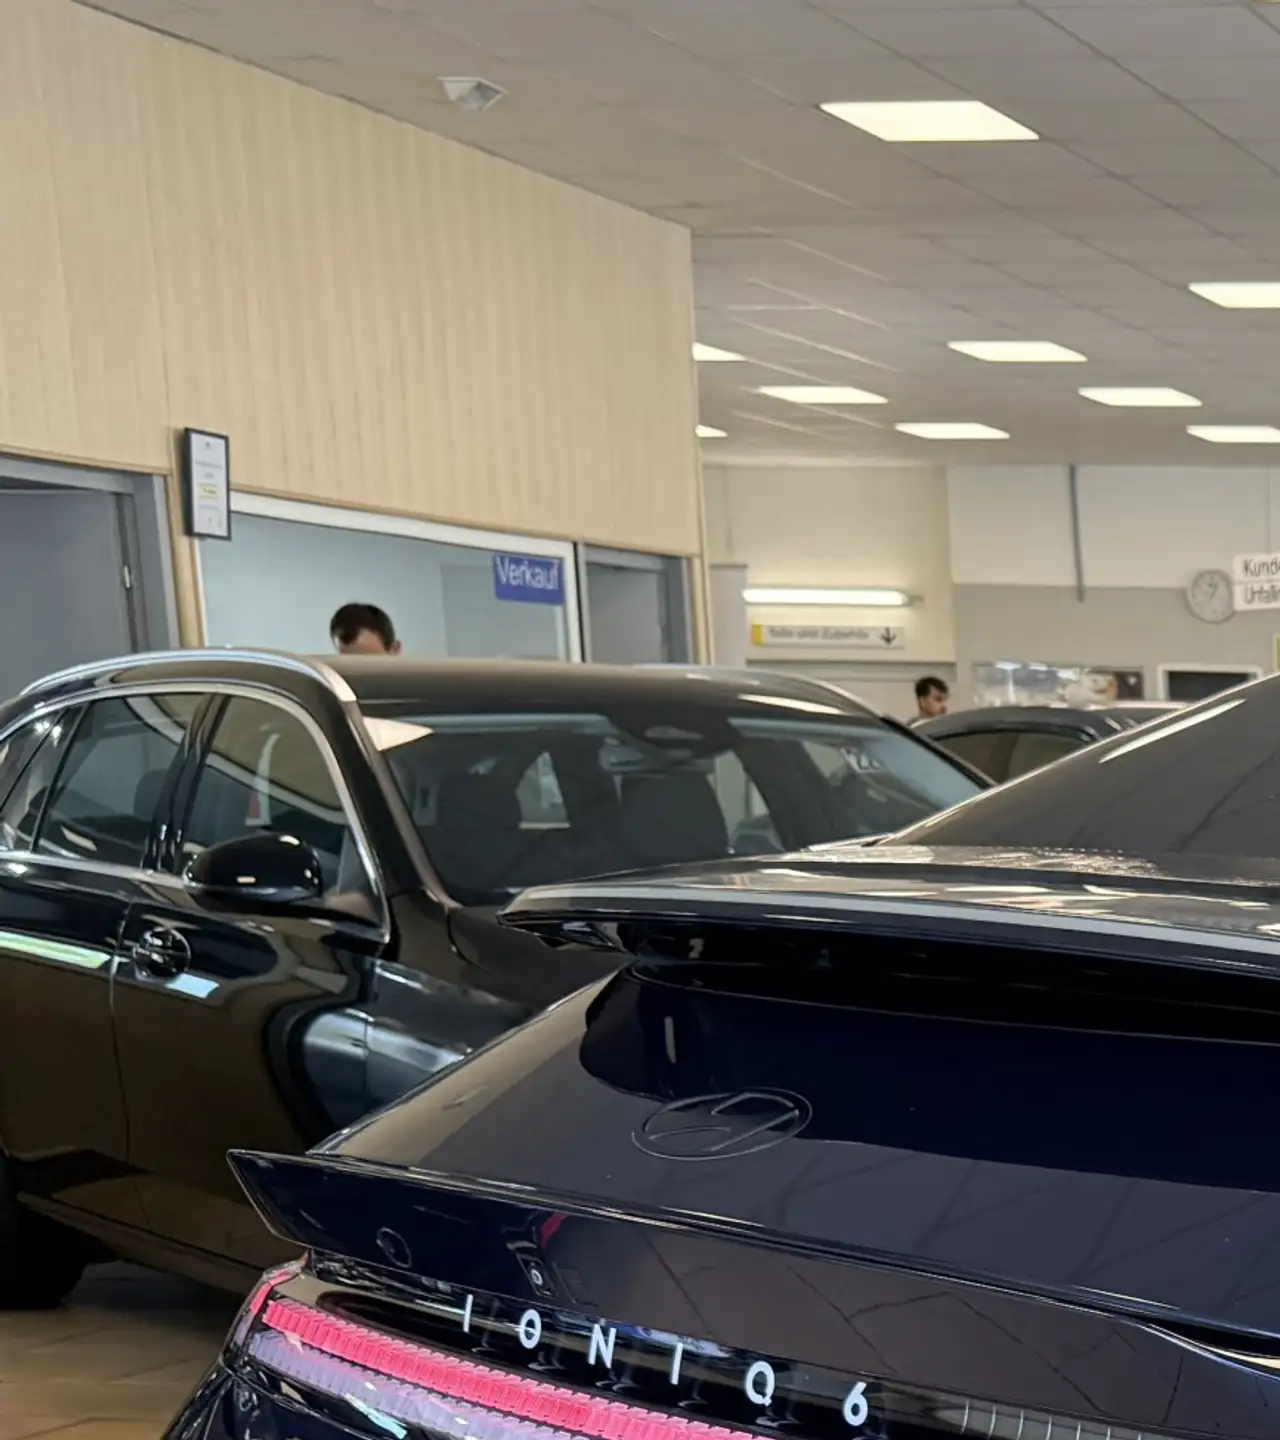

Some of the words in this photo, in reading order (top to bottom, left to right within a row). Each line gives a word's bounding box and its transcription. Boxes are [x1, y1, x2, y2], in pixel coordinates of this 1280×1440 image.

[495, 556, 559, 590] Verkauf
[462, 1294, 775, 1407] IONIQ
[842, 1381, 868, 1427] 6
